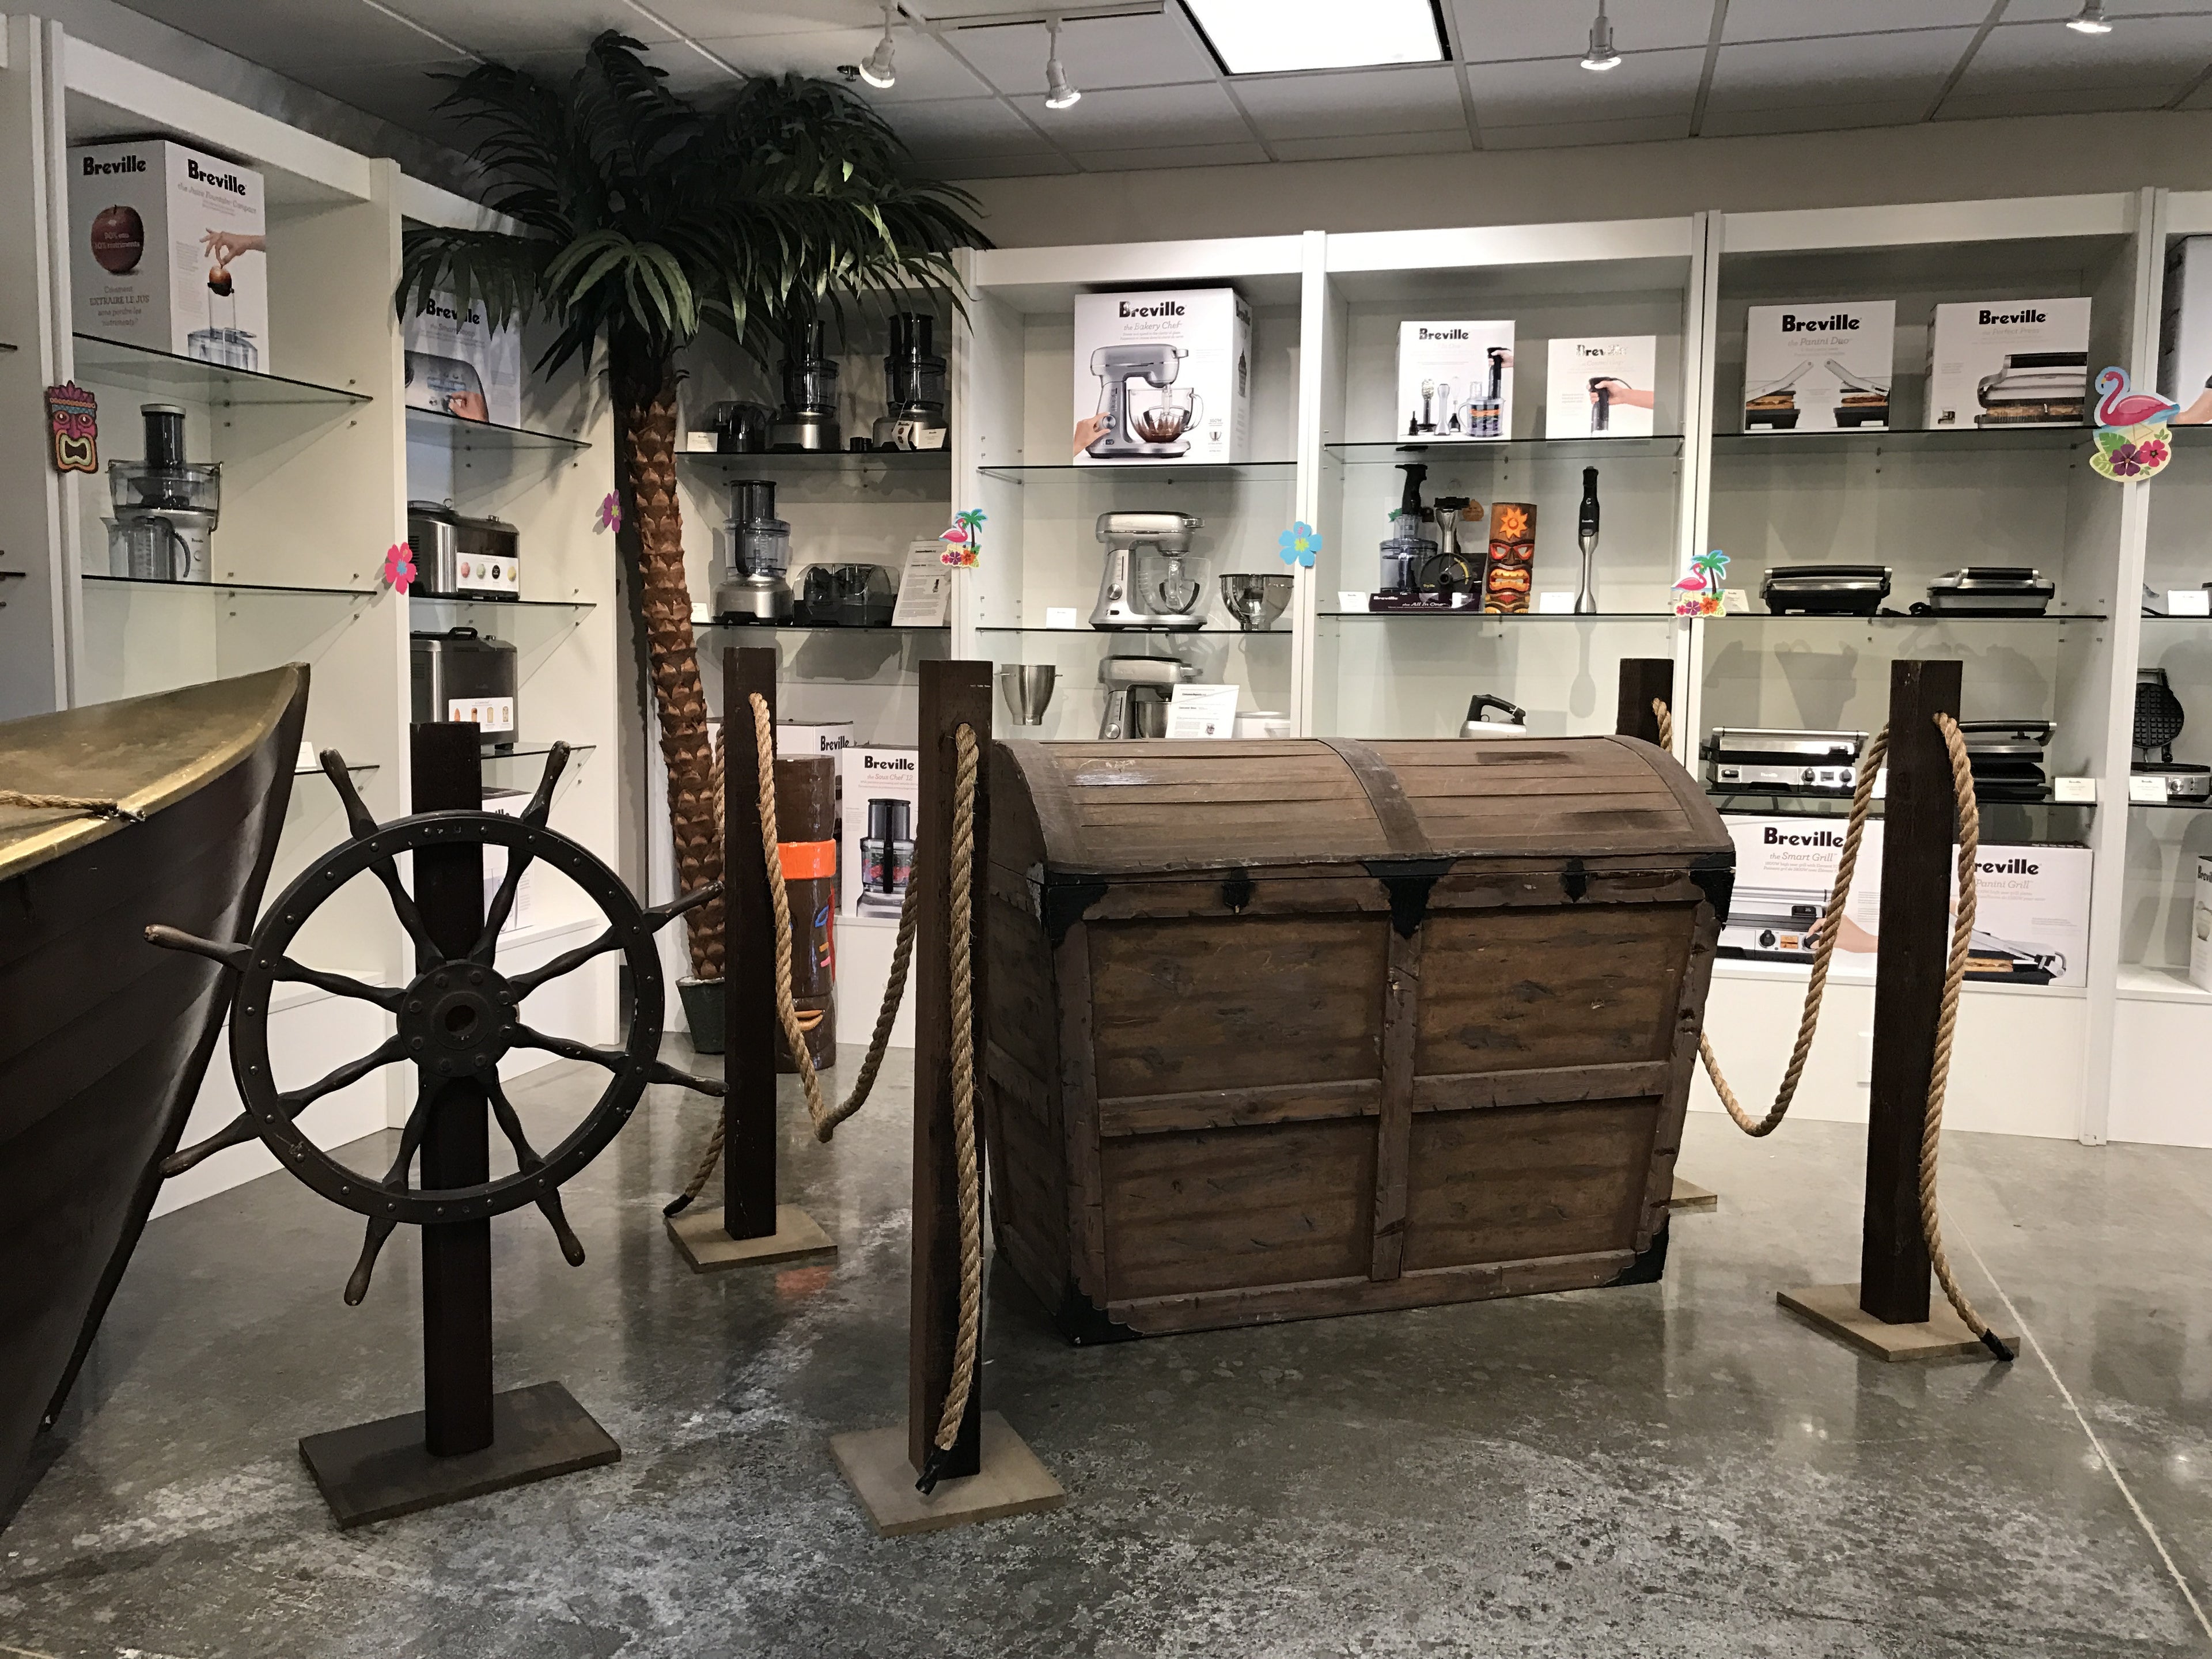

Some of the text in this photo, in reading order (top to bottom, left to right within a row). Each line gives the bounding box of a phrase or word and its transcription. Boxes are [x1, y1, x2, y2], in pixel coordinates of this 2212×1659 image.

[83, 155, 146, 175] Breville
[187, 158, 246, 196] Breville
[426, 298, 480, 325] Brevle
[1119, 301, 1185, 318] Breville
[1979, 309, 2046, 324] Breville
[1134, 322, 1161, 331] Bakery
[1161, 320, 1181, 329] Chef
[1782, 314, 1860, 332] Breville
[1419, 328, 1469, 340] Breville
[1800, 338, 1828, 346] Panini
[1830, 336, 1849, 345] Duo
[1576, 344, 1627, 356] Brev
[820, 735, 850, 751] Breville
[864, 756, 915, 770] Breville
[1764, 827, 1843, 847] Breville
[1782, 851, 1810, 861] Smart
[1812, 853, 1834, 862] Grill
[1975, 858, 2039, 875] reville
[1976, 878, 2029, 889] Panini Grill
